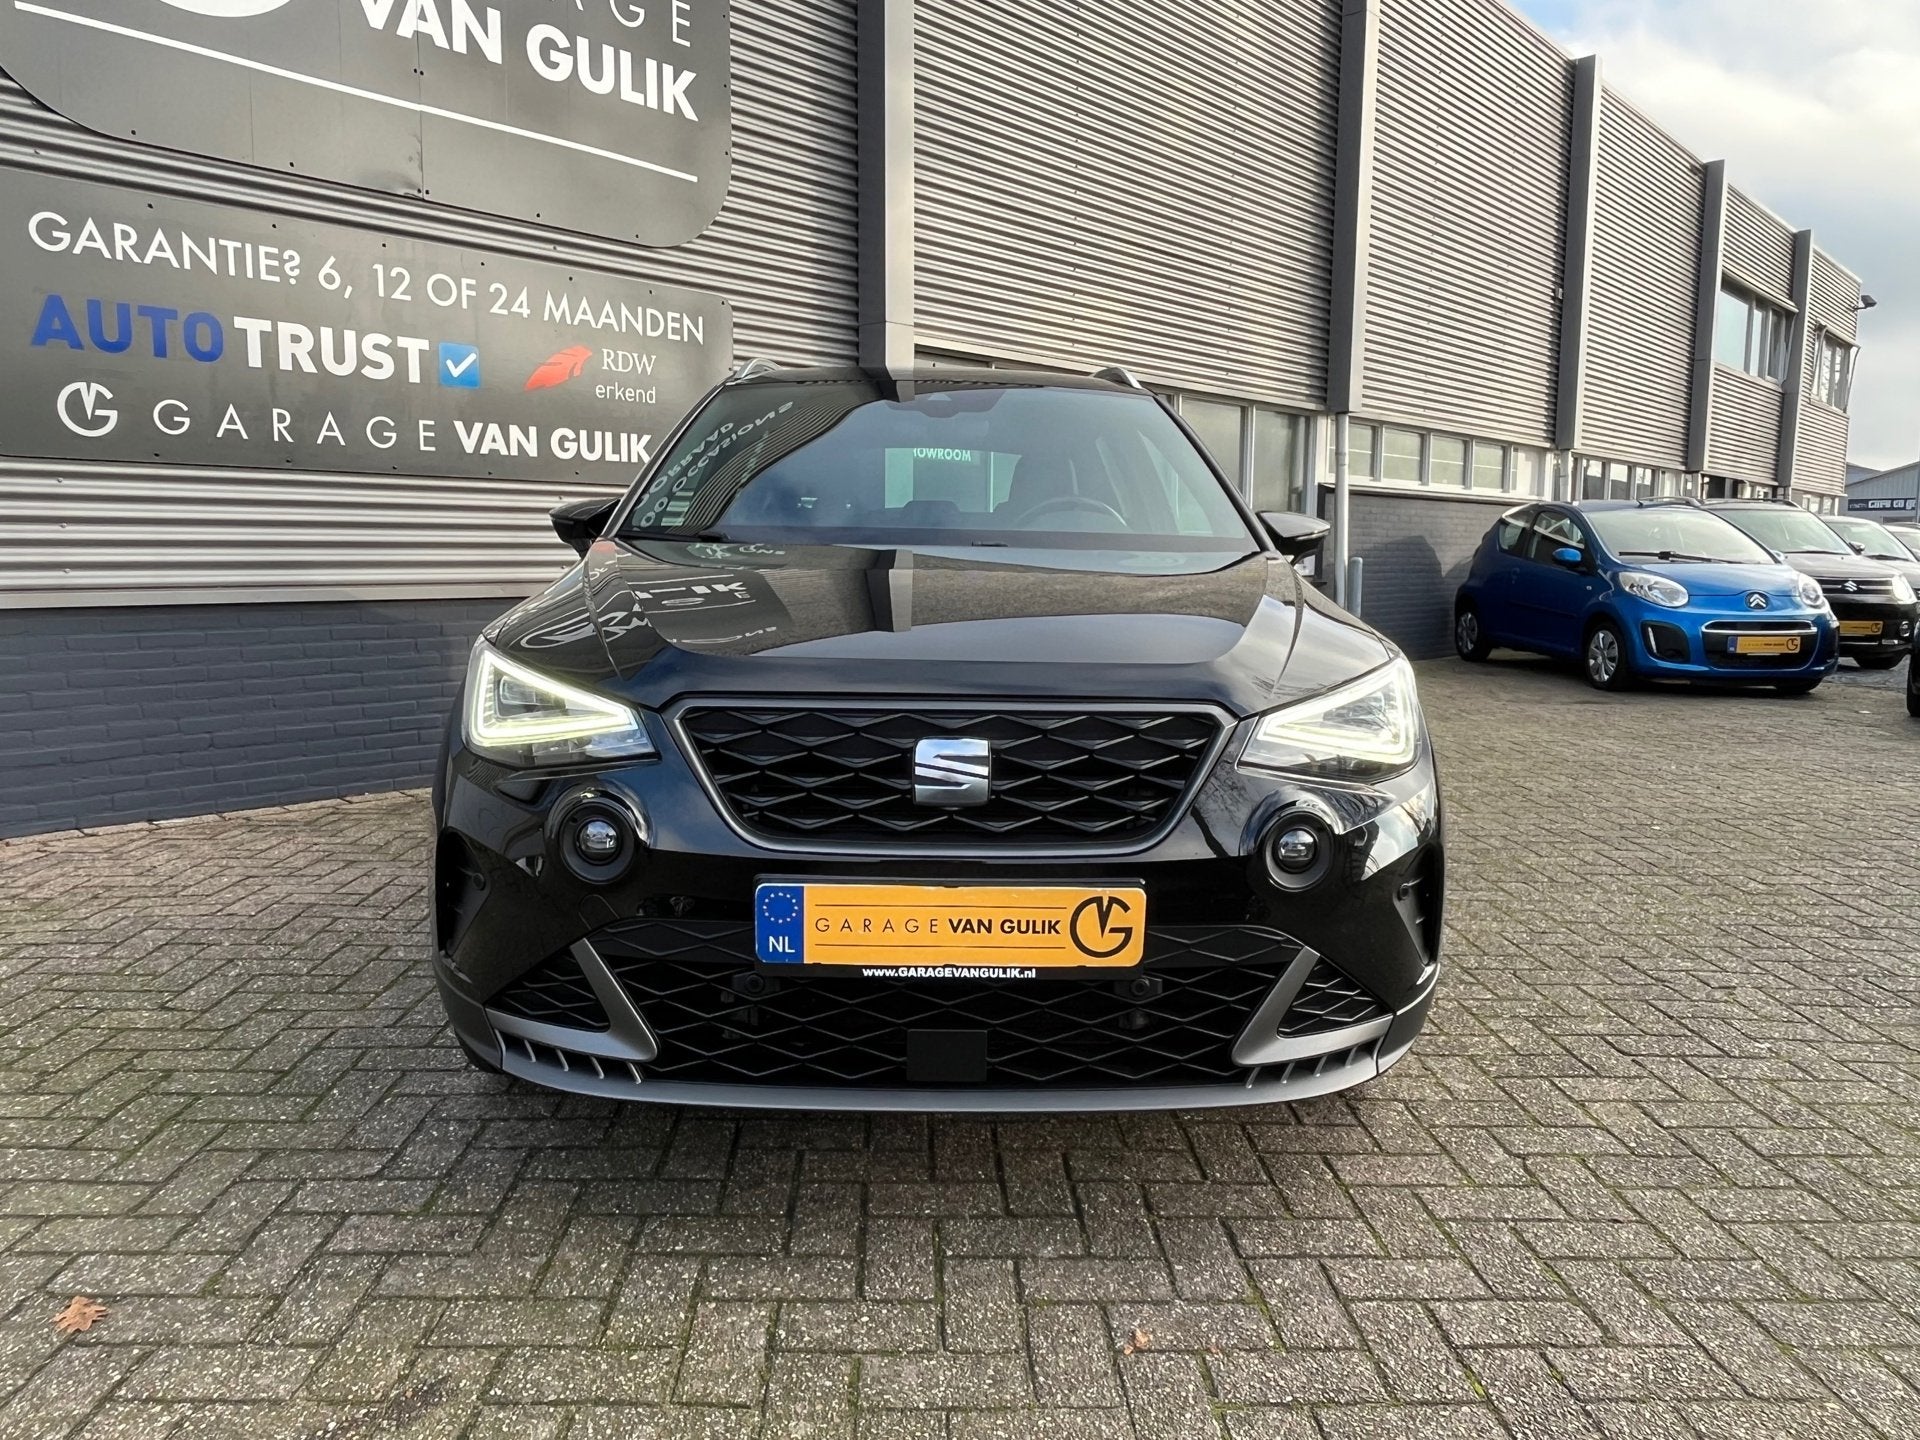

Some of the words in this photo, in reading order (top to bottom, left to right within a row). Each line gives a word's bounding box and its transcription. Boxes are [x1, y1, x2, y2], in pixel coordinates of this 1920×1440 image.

[525, 23, 699, 122] GULIK
[28, 211, 301, 285] GARANTIE?
[317, 255, 353, 299] 6,
[372, 263, 412, 301] 12
[426, 273, 477, 309] OF
[489, 282, 531, 318] 24
[543, 289, 705, 345] MAANDEN
[601, 348, 657, 376] RDW
[595, 381, 657, 404] erkend
[152, 398, 436, 452] GARAGE
[453, 420, 538, 457] VAN
[550, 427, 652, 464] GULIK
[814, 917, 939, 935] GARAGE
[948, 918, 993, 935] VAN
[999, 918, 1062, 935] GULIK
[768, 935, 796, 953] NL
[862, 966, 1037, 979] www.GARAGEVANGULIK.nl
